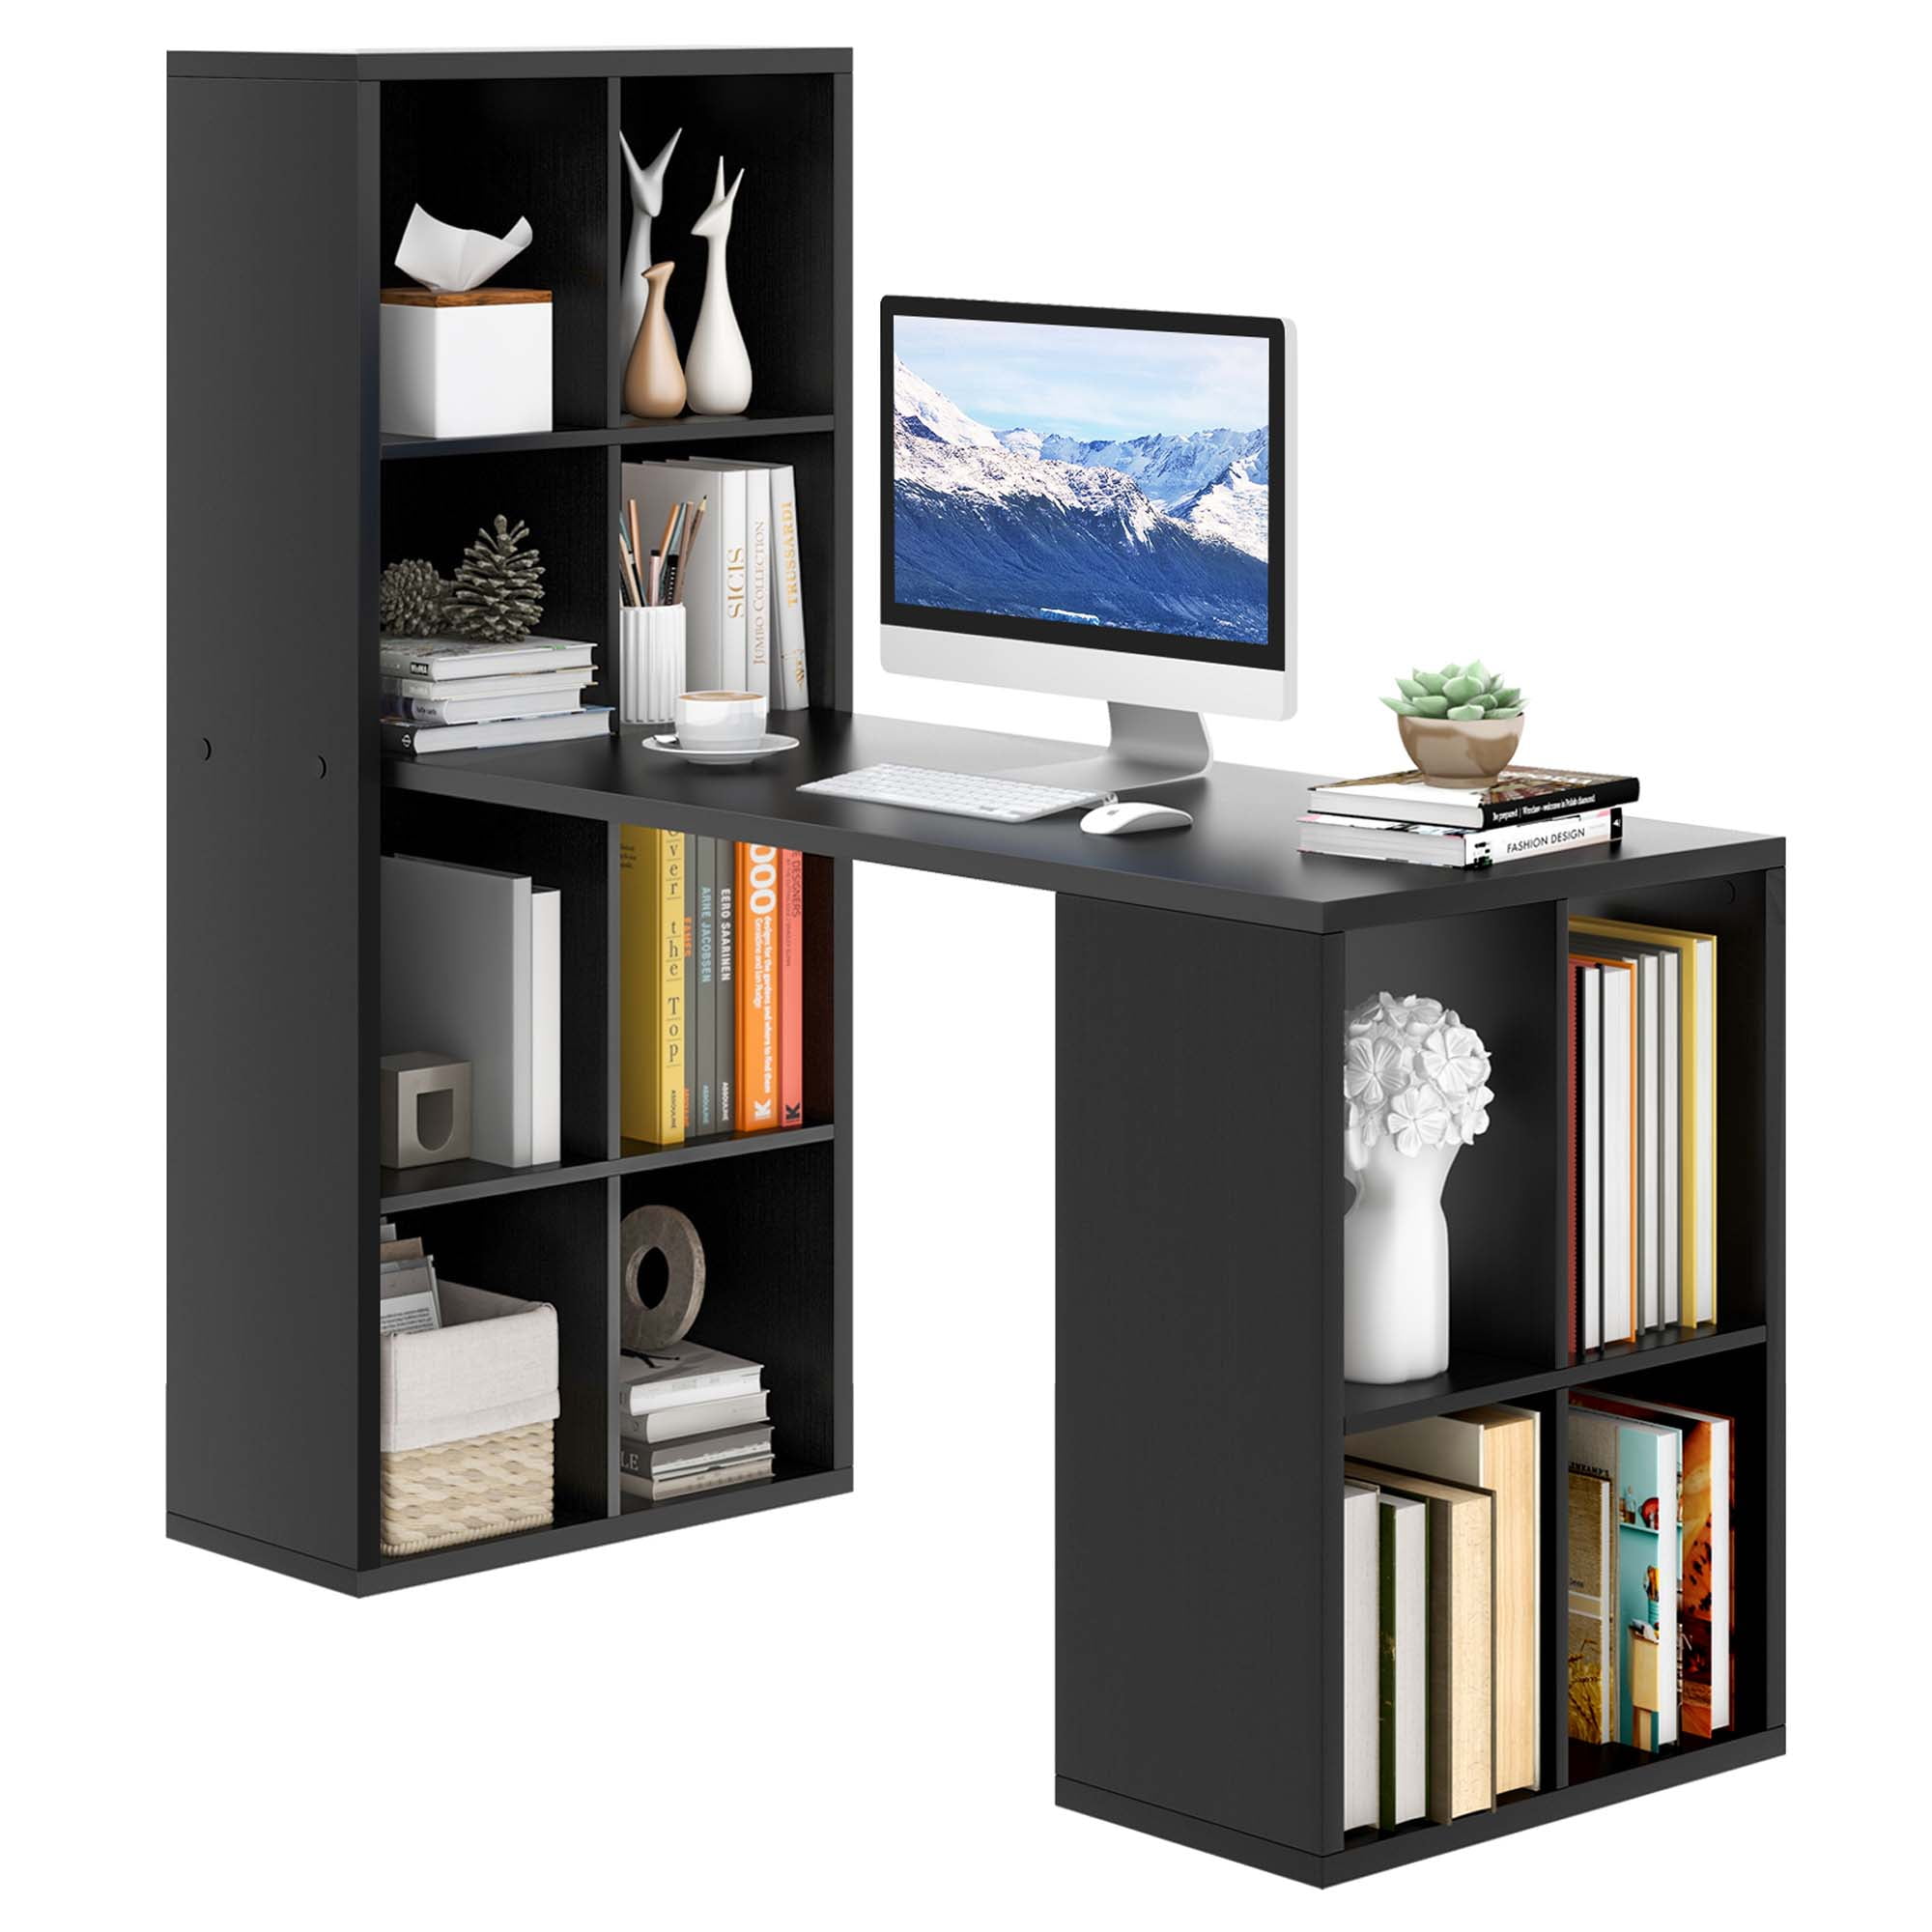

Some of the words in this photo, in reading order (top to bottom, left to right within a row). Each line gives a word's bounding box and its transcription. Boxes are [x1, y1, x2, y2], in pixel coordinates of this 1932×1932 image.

[726, 548, 745, 618] SICIS
[752, 521, 765, 612] COLLECTION
[780, 501, 799, 608] TRUSSARDI
[753, 616, 767, 666] JUMBO
[1507, 835, 1548, 854] FASHION
[1550, 828, 1586, 844] DESIGN
[701, 887, 712, 919] ARNE
[721, 889, 731, 919] EERO
[792, 860, 801, 918] DESIGNERS
[668, 920, 680, 976] the
[701, 922, 712, 983] JACOBSEN
[721, 922, 731, 981] SAARINEN
[667, 996, 680, 1063] Top
